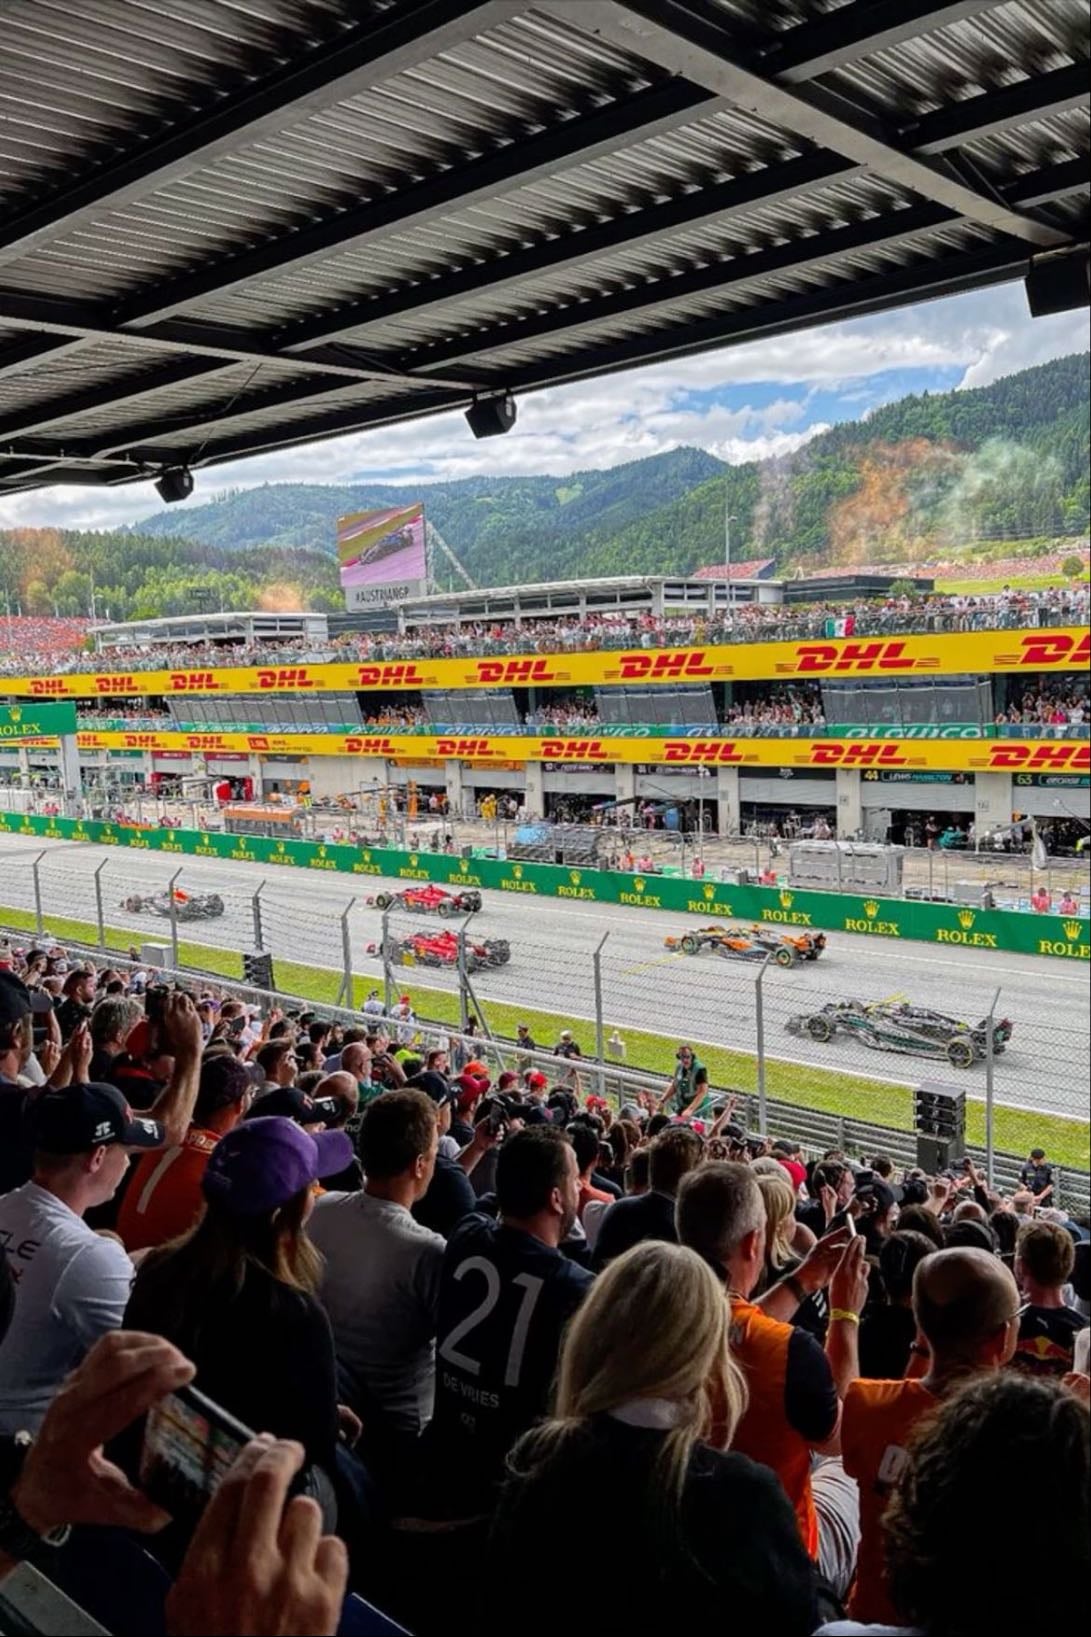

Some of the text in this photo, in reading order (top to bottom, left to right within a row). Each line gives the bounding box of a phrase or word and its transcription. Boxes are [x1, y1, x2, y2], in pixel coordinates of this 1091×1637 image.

[796, 642, 917, 672] DHL
[477, 661, 555, 682] DHL
[619, 653, 714, 678] DHL
[171, 673, 220, 689] DHL
[257, 670, 314, 688] DHL
[358, 665, 424, 686] DHL
[31, 680, 68, 693] DHL
[96, 677, 138, 692] DHL
[125, 736, 161, 747] DHL
[186, 737, 227, 748] DHL
[345, 738, 396, 753] DHL
[436, 740, 494, 755] DHL
[541, 740, 608, 758] DHL
[664, 743, 743, 761] DHL
[811, 744, 907, 764] DHL
[864, 770, 879, 780] 44
[1017, 774, 1033, 785] 63
[310, 858, 337, 870] ROLEX
[353, 863, 382, 874] ROLEX
[400, 868, 430, 880] ROLEX
[449, 873, 481, 886] ROLEX
[502, 878, 537, 892] ROLEX
[557, 885, 596, 900] ROLEX
[620, 892, 661, 907] ROLEX
[688, 901, 733, 916] ROLEX
[762, 909, 812, 925] ROLEX
[845, 918, 900, 936] ROLEX
[937, 928, 998, 948] ROLEX
[439, 1255, 545, 1388] 21
[460, 1382, 500, 1408] VRIES
